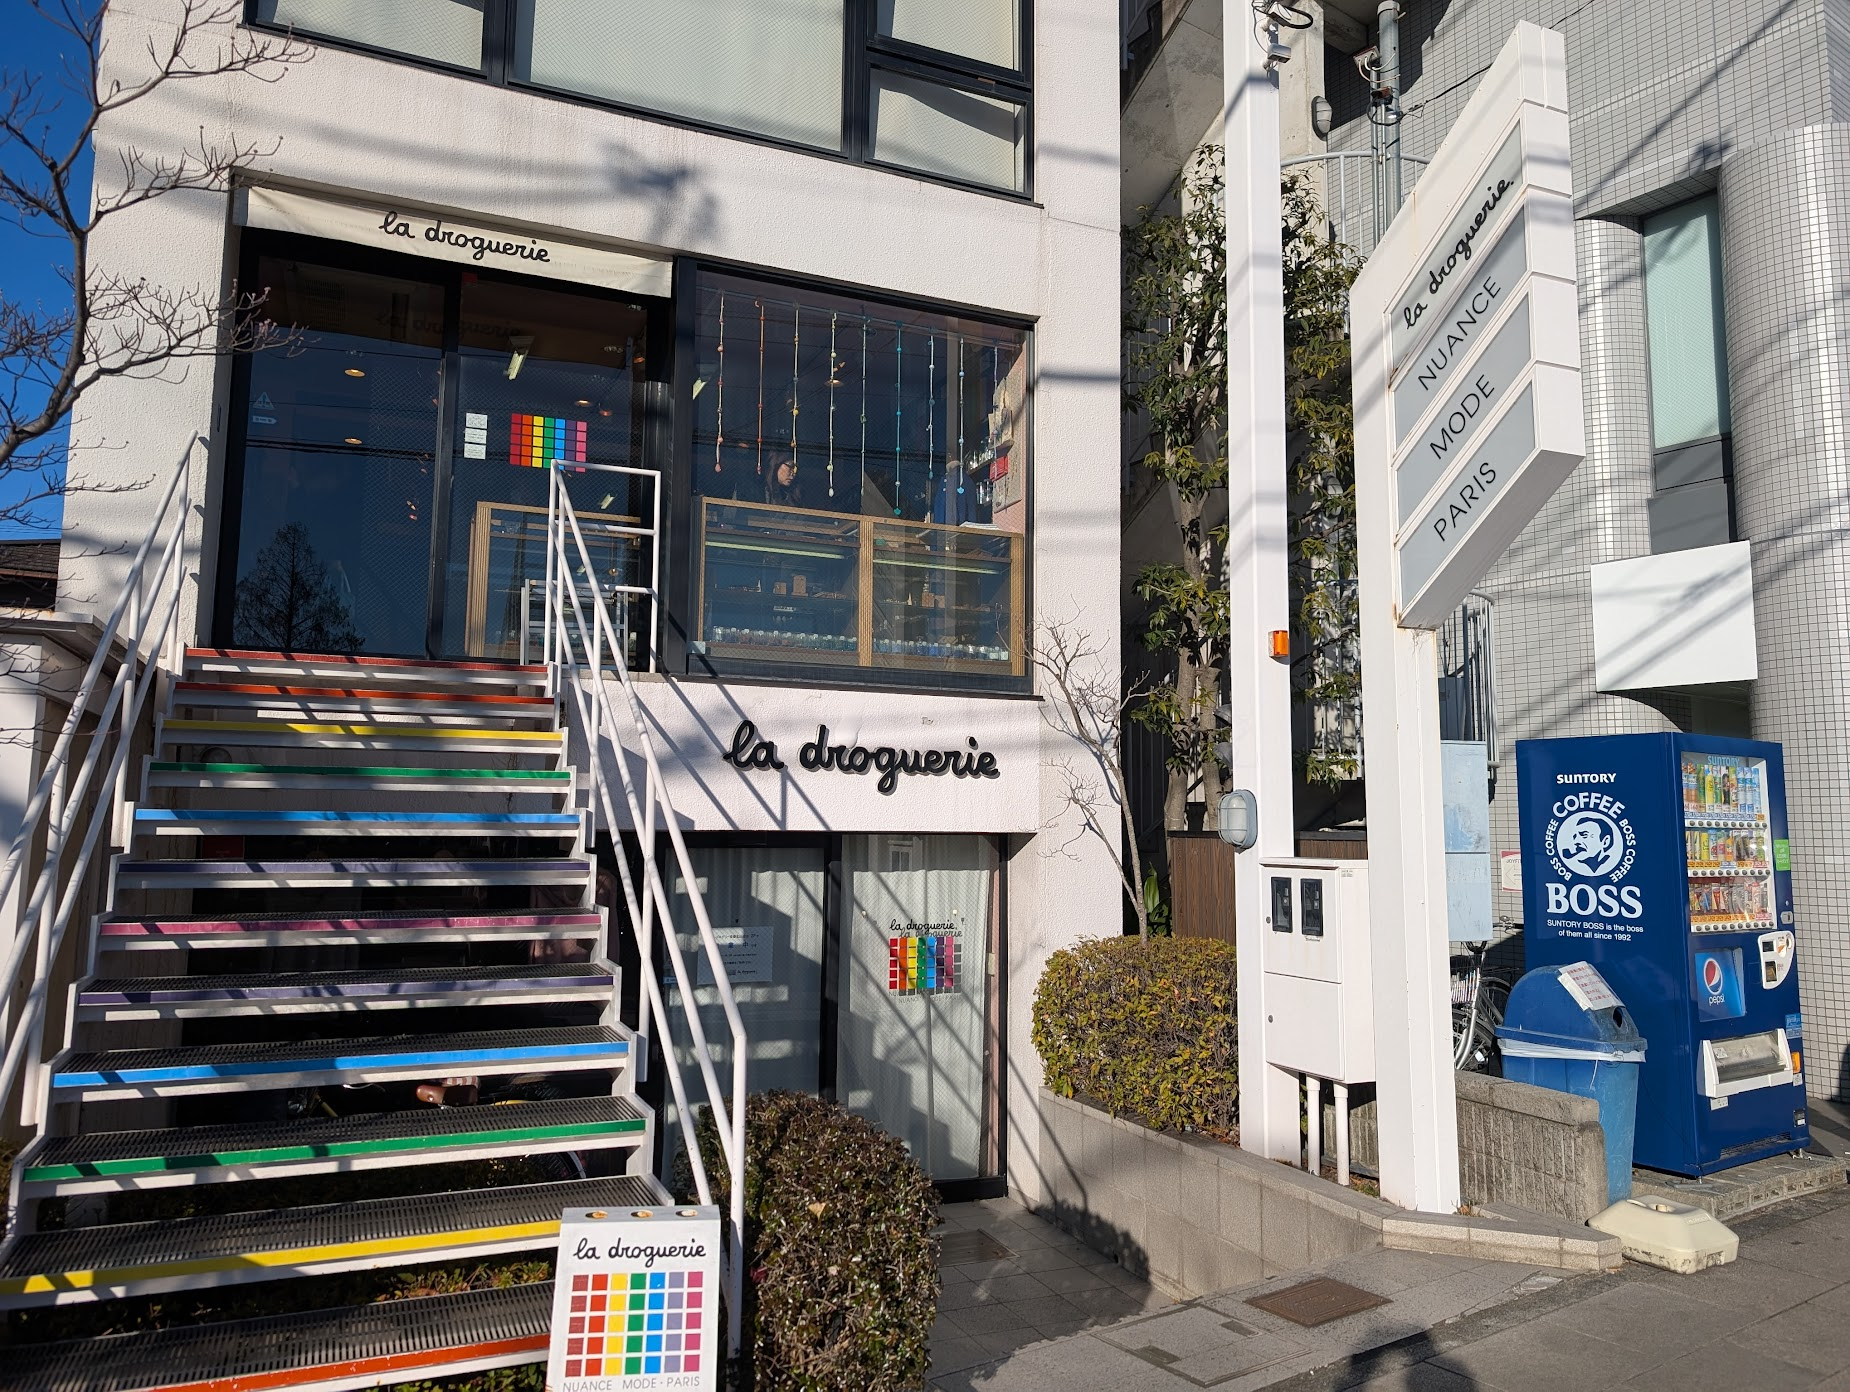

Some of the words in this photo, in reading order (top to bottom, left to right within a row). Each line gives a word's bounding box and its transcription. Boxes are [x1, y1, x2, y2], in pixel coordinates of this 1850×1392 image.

[378, 210, 416, 239] la
[424, 219, 551, 263] droguerie
[1403, 300, 1428, 330] la
[1418, 275, 1501, 391] NUANCE
[1429, 374, 1495, 460] MODE
[1433, 462, 1497, 542] PARIS
[722, 719, 785, 770] la
[799, 723, 1000, 794] droguerie
[1552, 791, 1625, 819] COFFEE
[1545, 818, 1559, 856] COFFEE
[1618, 818, 1637, 846] BOSS
[1549, 857, 1573, 881] BOSS
[1609, 848, 1636, 883] COFFEE
[1545, 882, 1643, 919] BOSS
[889, 918, 901, 931] la
[1547, 919, 1581, 929] SUNTORY
[1583, 921, 1605, 930] BOSS
[1606, 923, 1612, 931] is
[1613, 923, 1625, 932] the
[1626, 924, 1644, 933] boss
[1558, 929, 1565, 937] of
[1566, 929, 1583, 938] them
[1584, 931, 1593, 939] all
[1593, 932, 1612, 940] since
[1614, 933, 1632, 942] 1992
[1708, 993, 1725, 1006] pepsi
[573, 1237, 601, 1260] la
[608, 1237, 707, 1268] droguerie
[562, 1379, 613, 1392] NUANCE
[622, 1377, 657, 1390] MODE
[666, 1375, 700, 1388] PARIS
